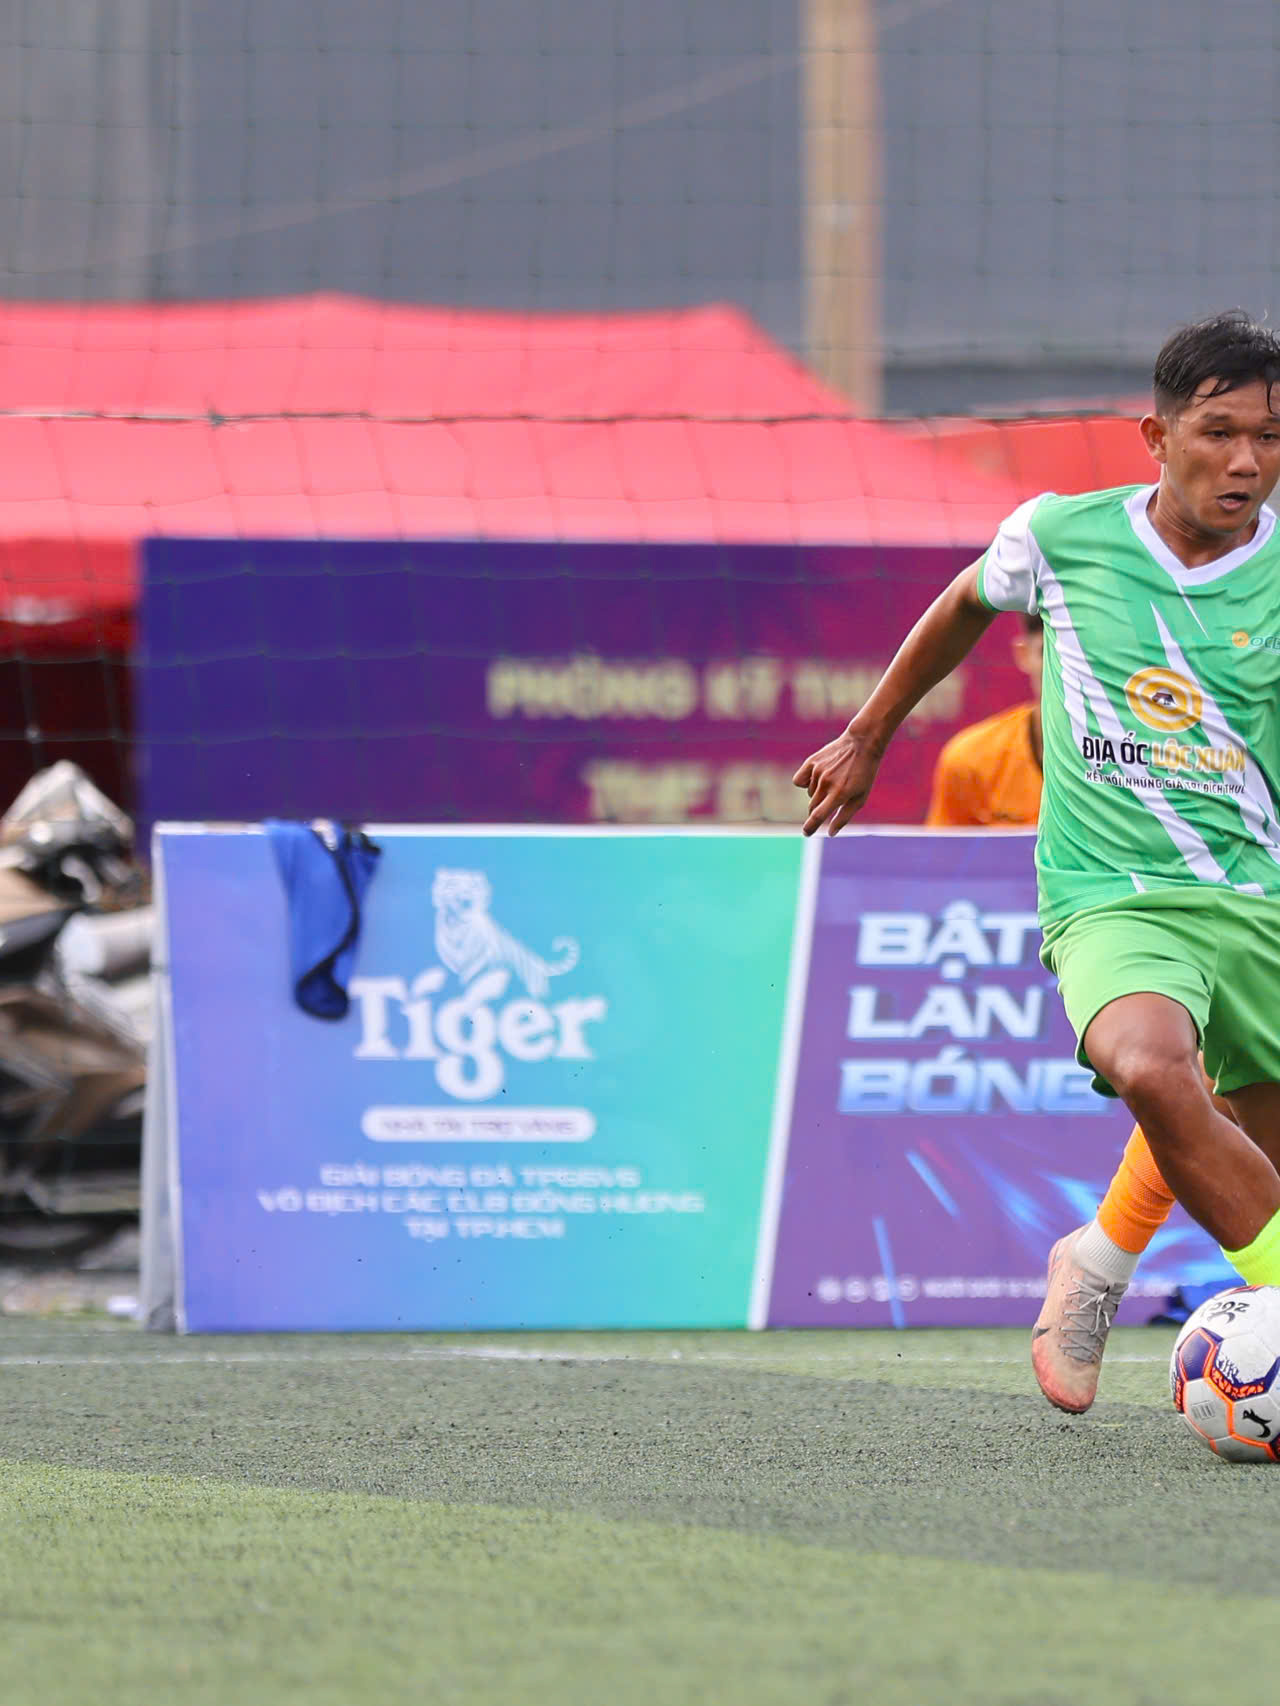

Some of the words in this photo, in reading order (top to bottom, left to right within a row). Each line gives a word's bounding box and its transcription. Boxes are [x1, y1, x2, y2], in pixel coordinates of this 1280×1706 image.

[1083, 736, 1117, 768] ĐỊA
[1120, 732, 1149, 766] ỐC
[1152, 738, 1192, 774] LỘC
[855, 899, 1039, 980] BẬT
[348, 967, 608, 1101] Tiger
[838, 1043, 1109, 1113] BÓNG
